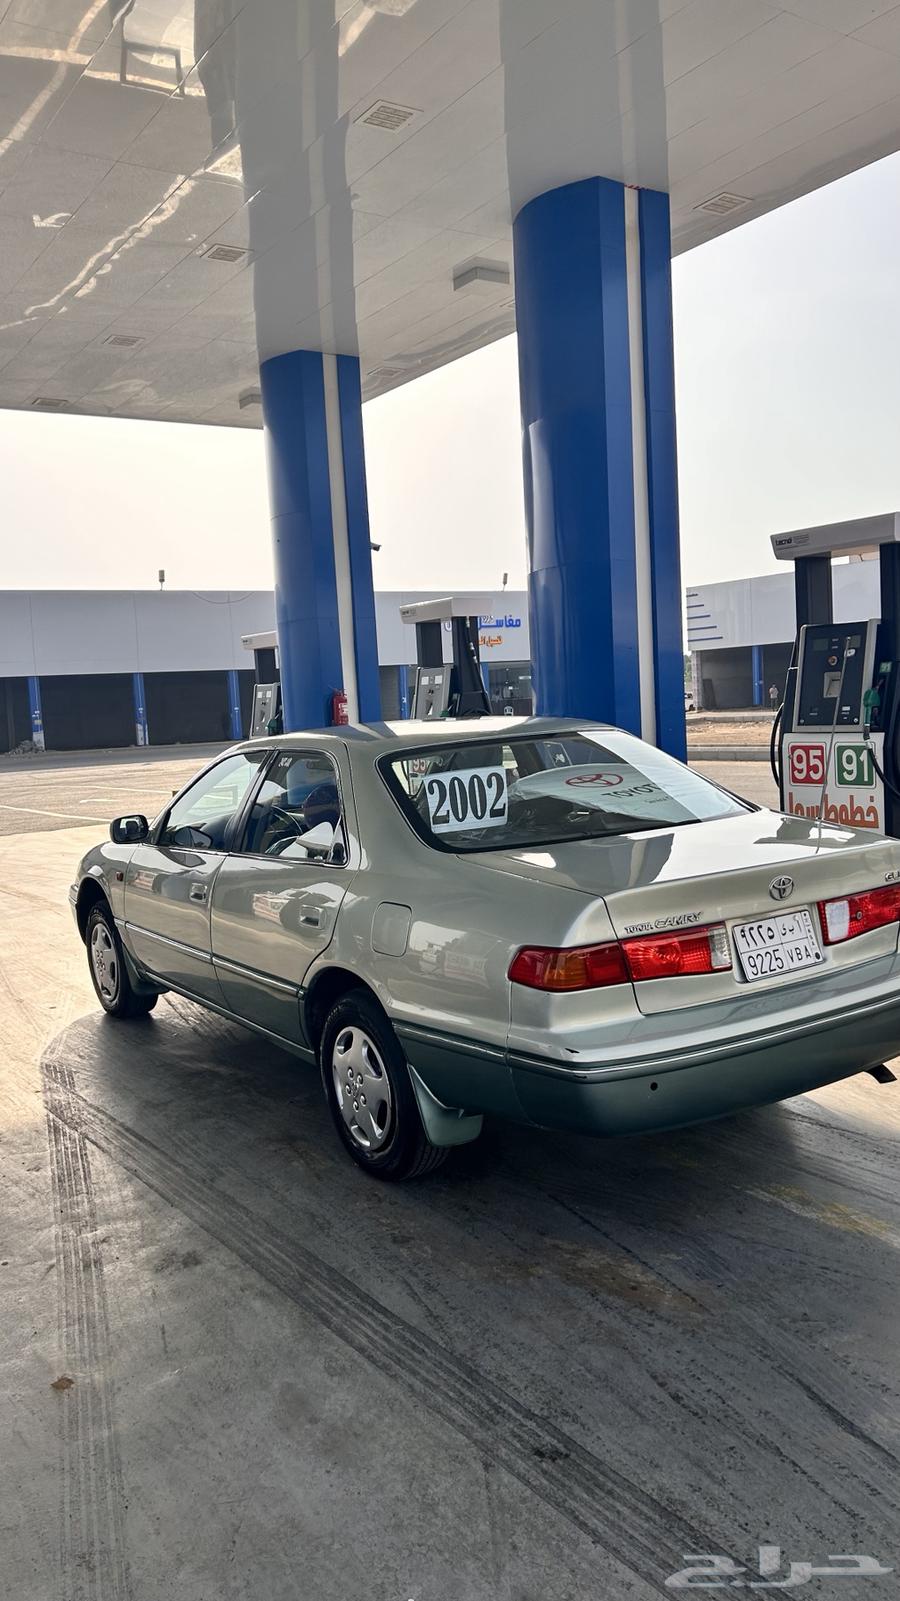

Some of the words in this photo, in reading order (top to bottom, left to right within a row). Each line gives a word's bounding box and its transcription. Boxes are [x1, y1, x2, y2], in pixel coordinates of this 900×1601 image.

[793, 749, 823, 780] 95
[842, 749, 869, 782] 91
[427, 772, 506, 825] 2002
[601, 783, 661, 799] TOYOT
[655, 911, 703, 929] CAMRY
[747, 948, 784, 976] 9225
